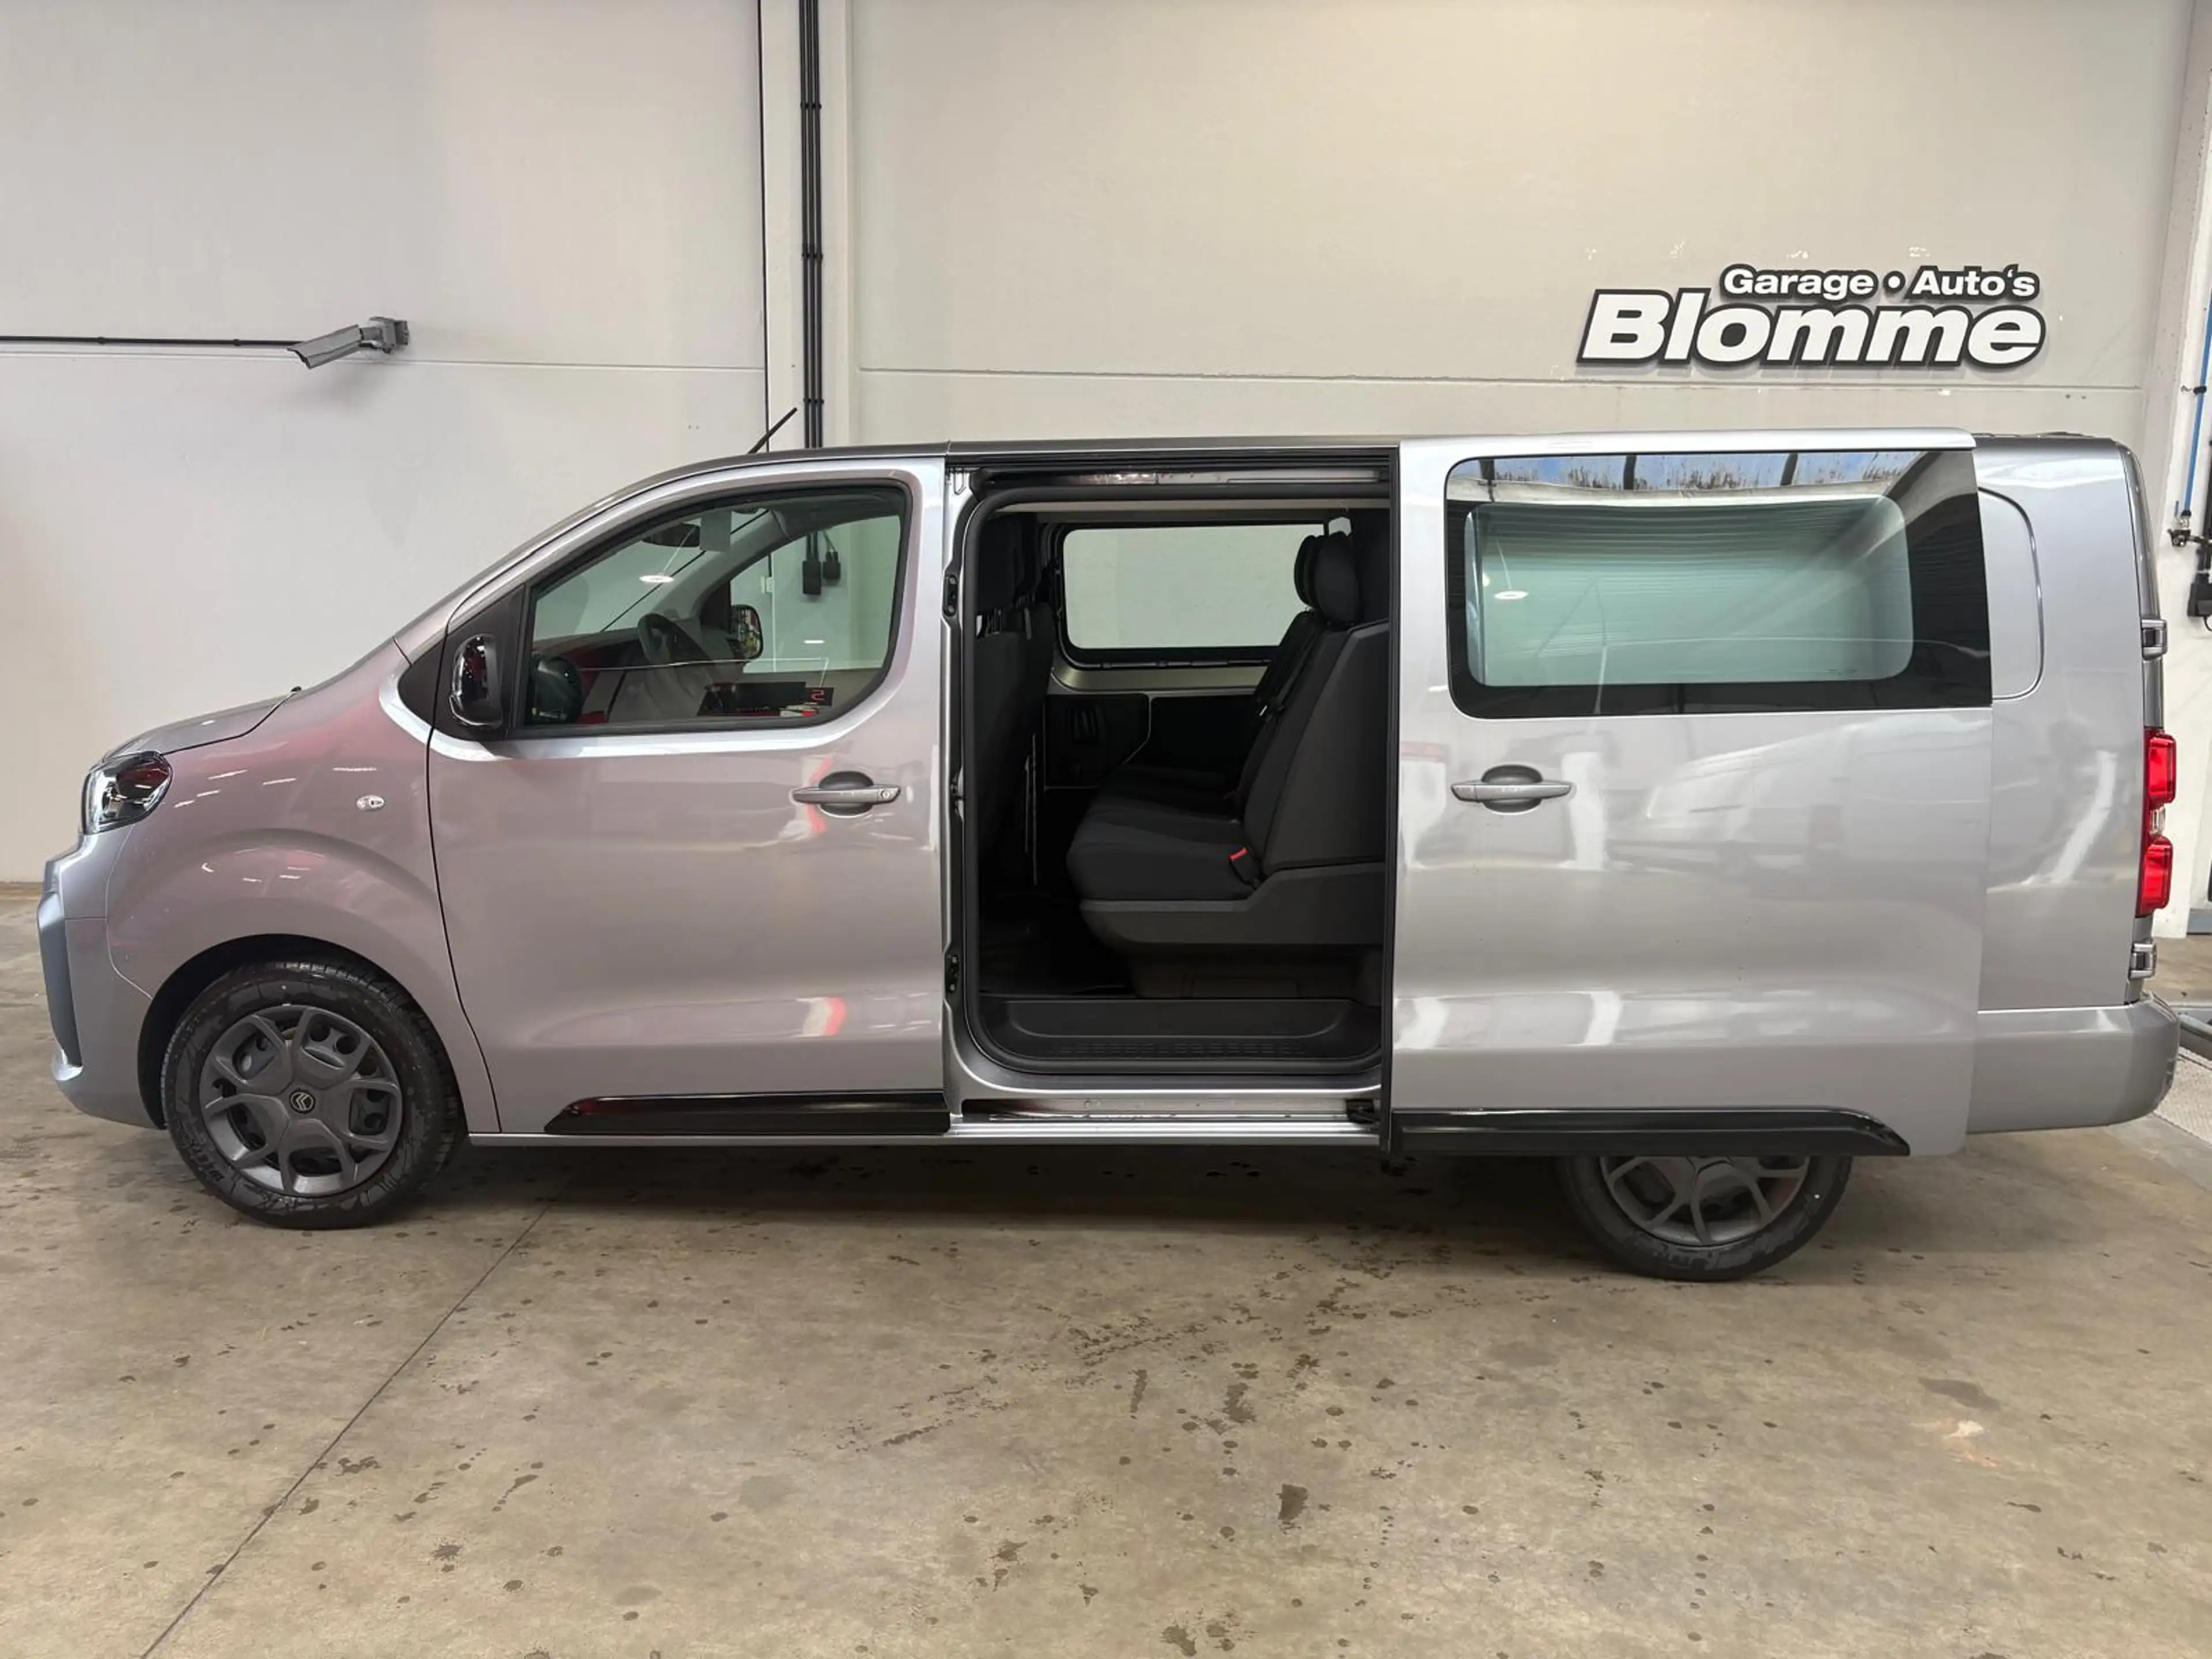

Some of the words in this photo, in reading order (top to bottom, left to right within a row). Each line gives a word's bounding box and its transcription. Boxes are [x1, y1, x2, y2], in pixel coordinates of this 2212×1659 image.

[1725, 269, 1873, 300] Garage
[1912, 270, 2034, 296] Auto's
[1582, 293, 2041, 362] Blomme
